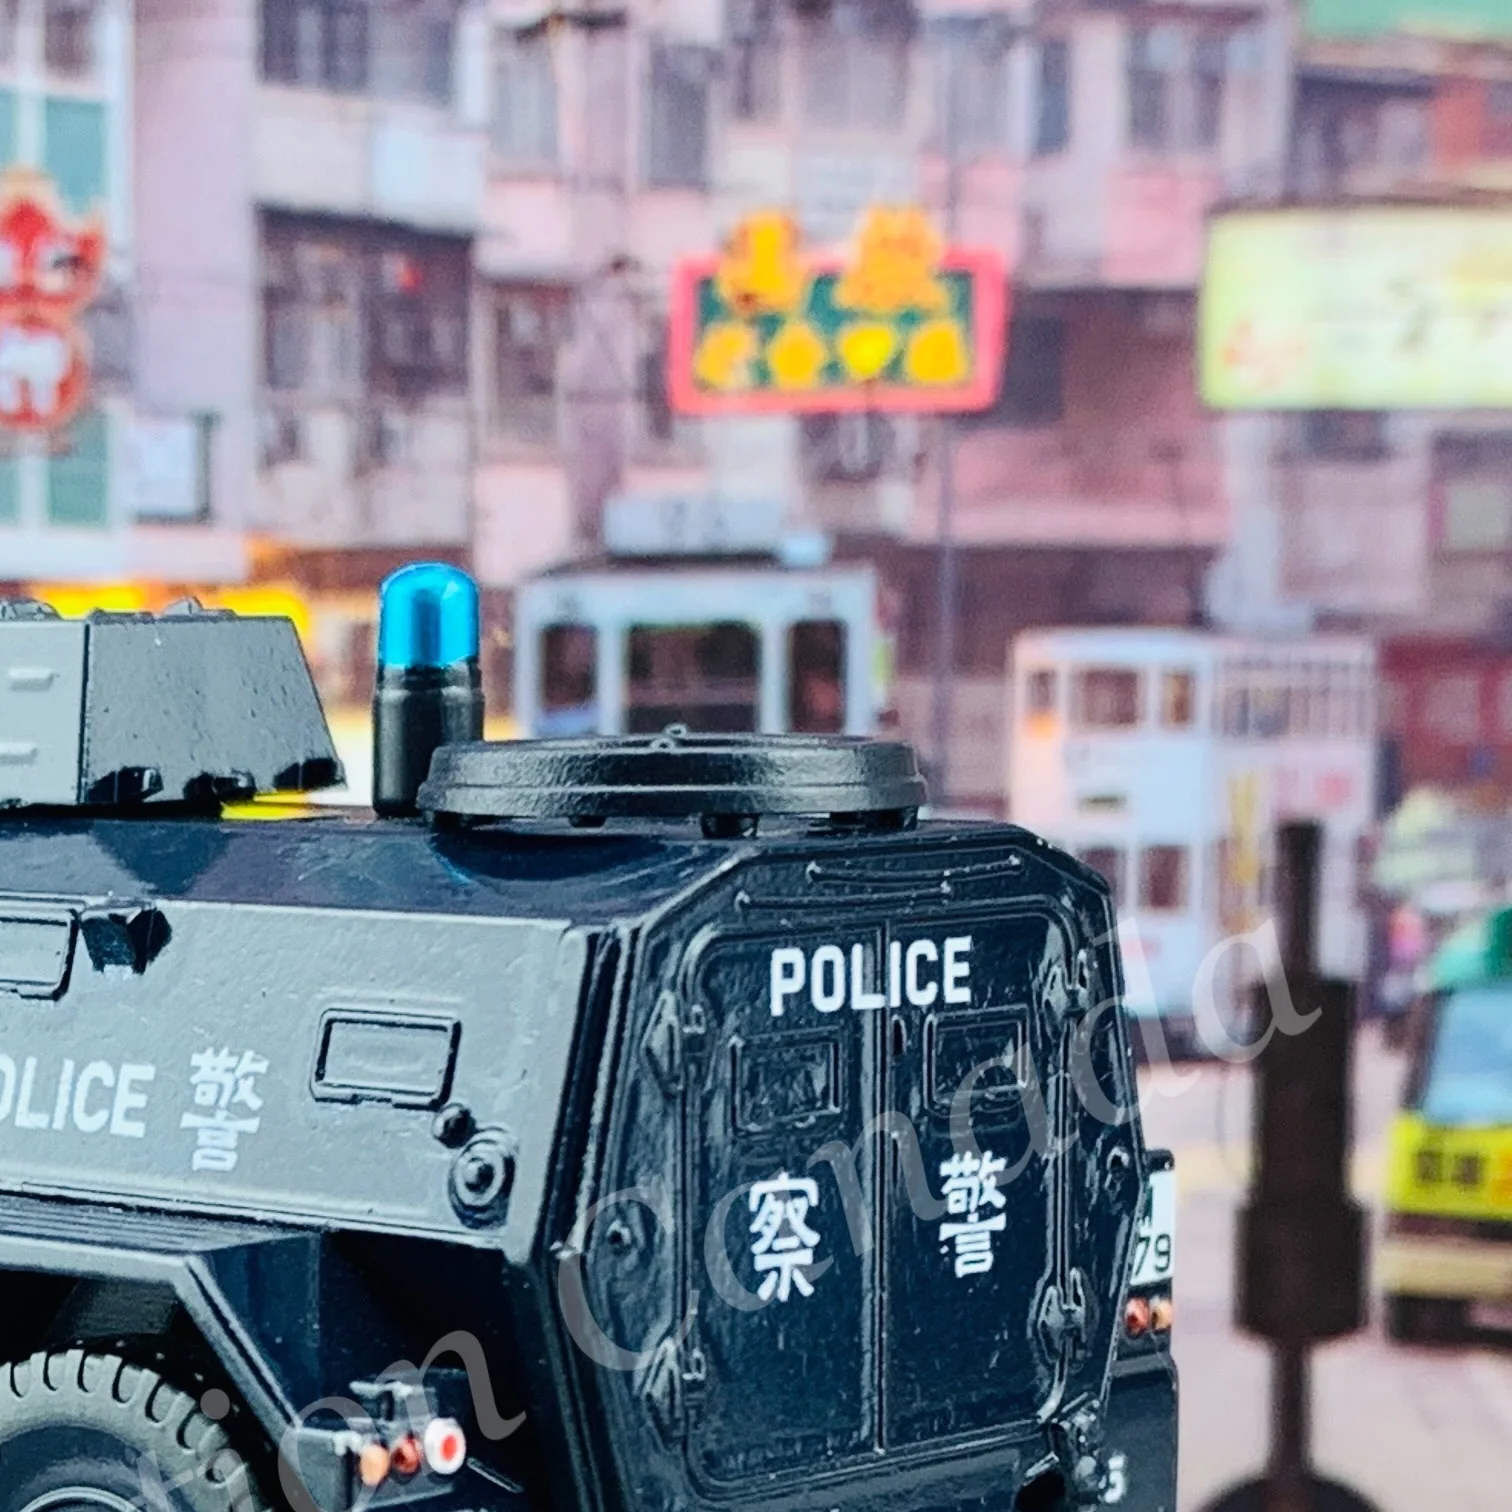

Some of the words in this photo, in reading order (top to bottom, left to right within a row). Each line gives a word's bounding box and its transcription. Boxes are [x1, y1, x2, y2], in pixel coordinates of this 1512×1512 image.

[770, 935, 973, 1016] POLICE
[181, 1045, 269, 1172] 警
[748, 1171, 822, 1302] 察
[939, 1150, 1008, 1279] 警
[1135, 1233, 1171, 1277] 79
